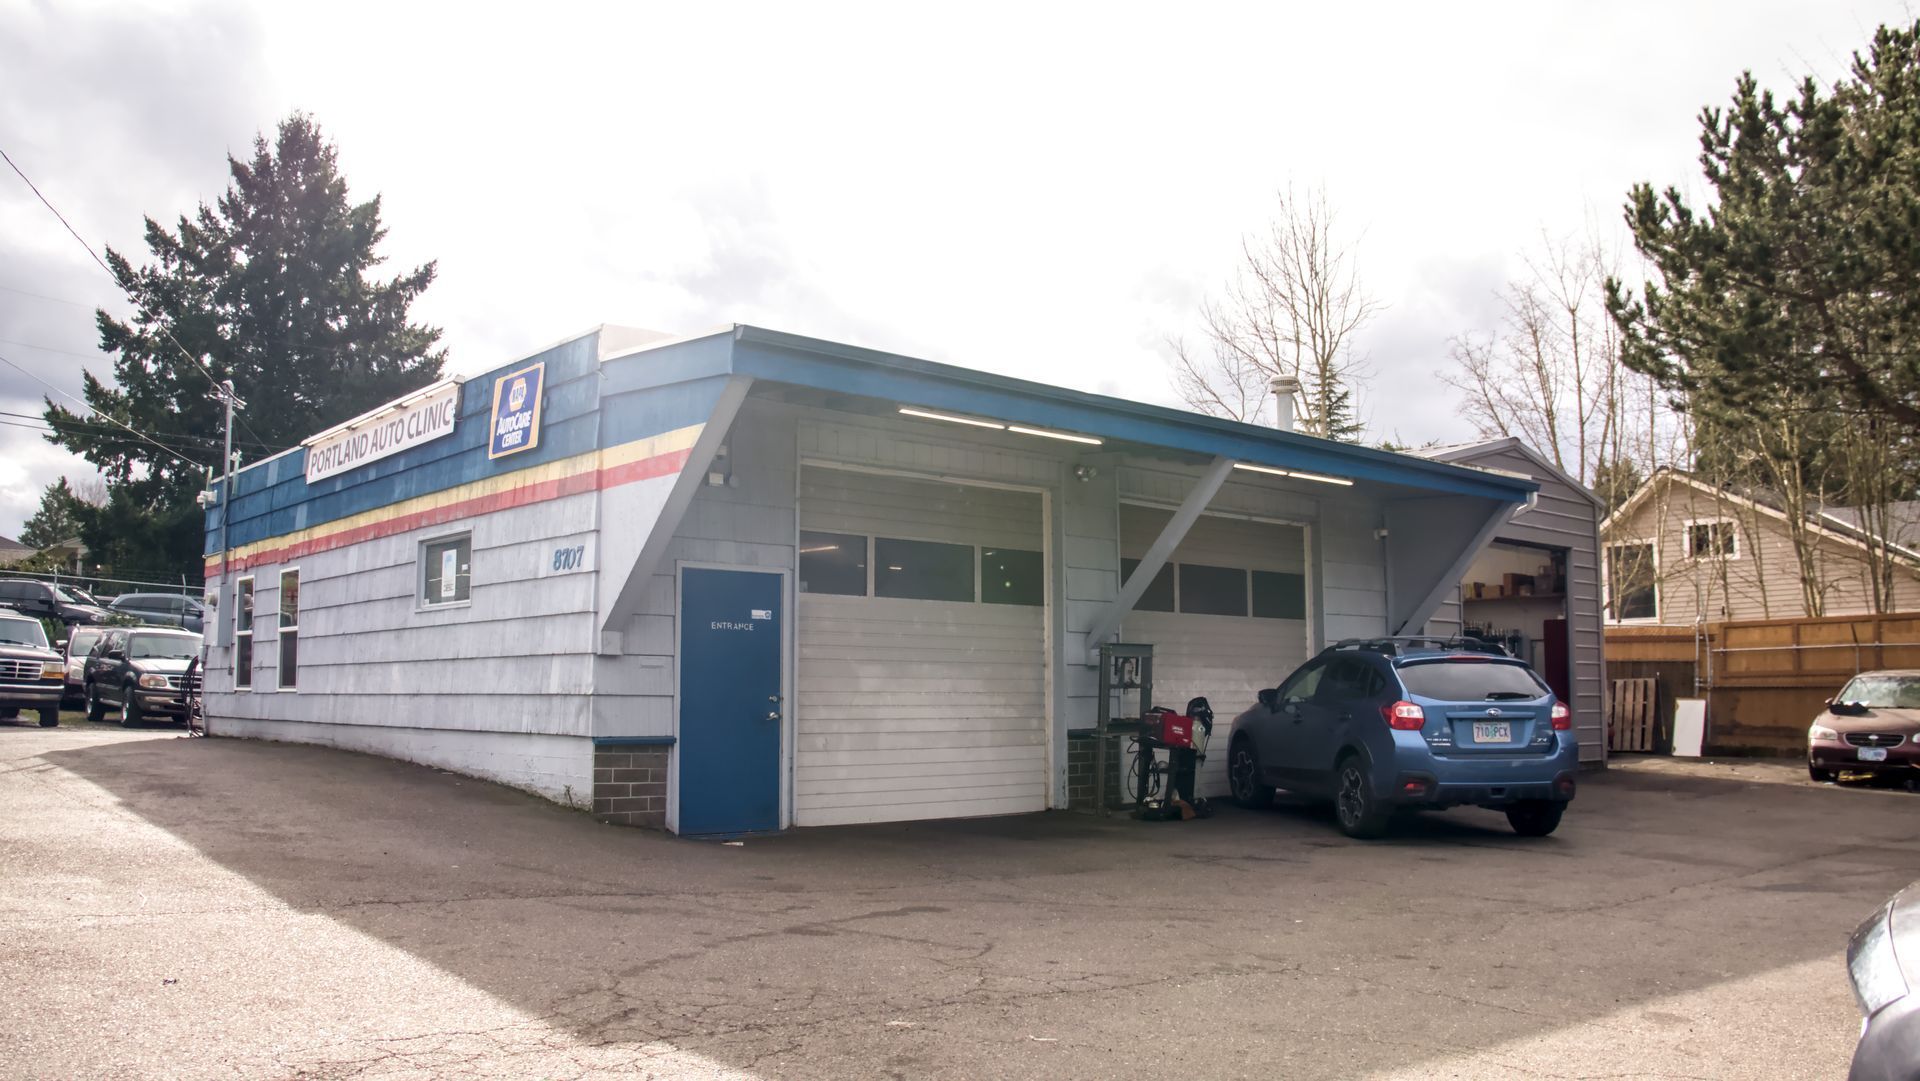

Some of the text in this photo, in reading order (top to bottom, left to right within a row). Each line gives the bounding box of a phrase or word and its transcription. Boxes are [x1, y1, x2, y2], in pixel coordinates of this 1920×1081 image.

[310, 398, 453, 476] PORTLAND AUTO CLINIC
[502, 429, 523, 449] CENTER
[553, 545, 584, 571] 8707
[711, 621, 755, 631] ENTRANCE
